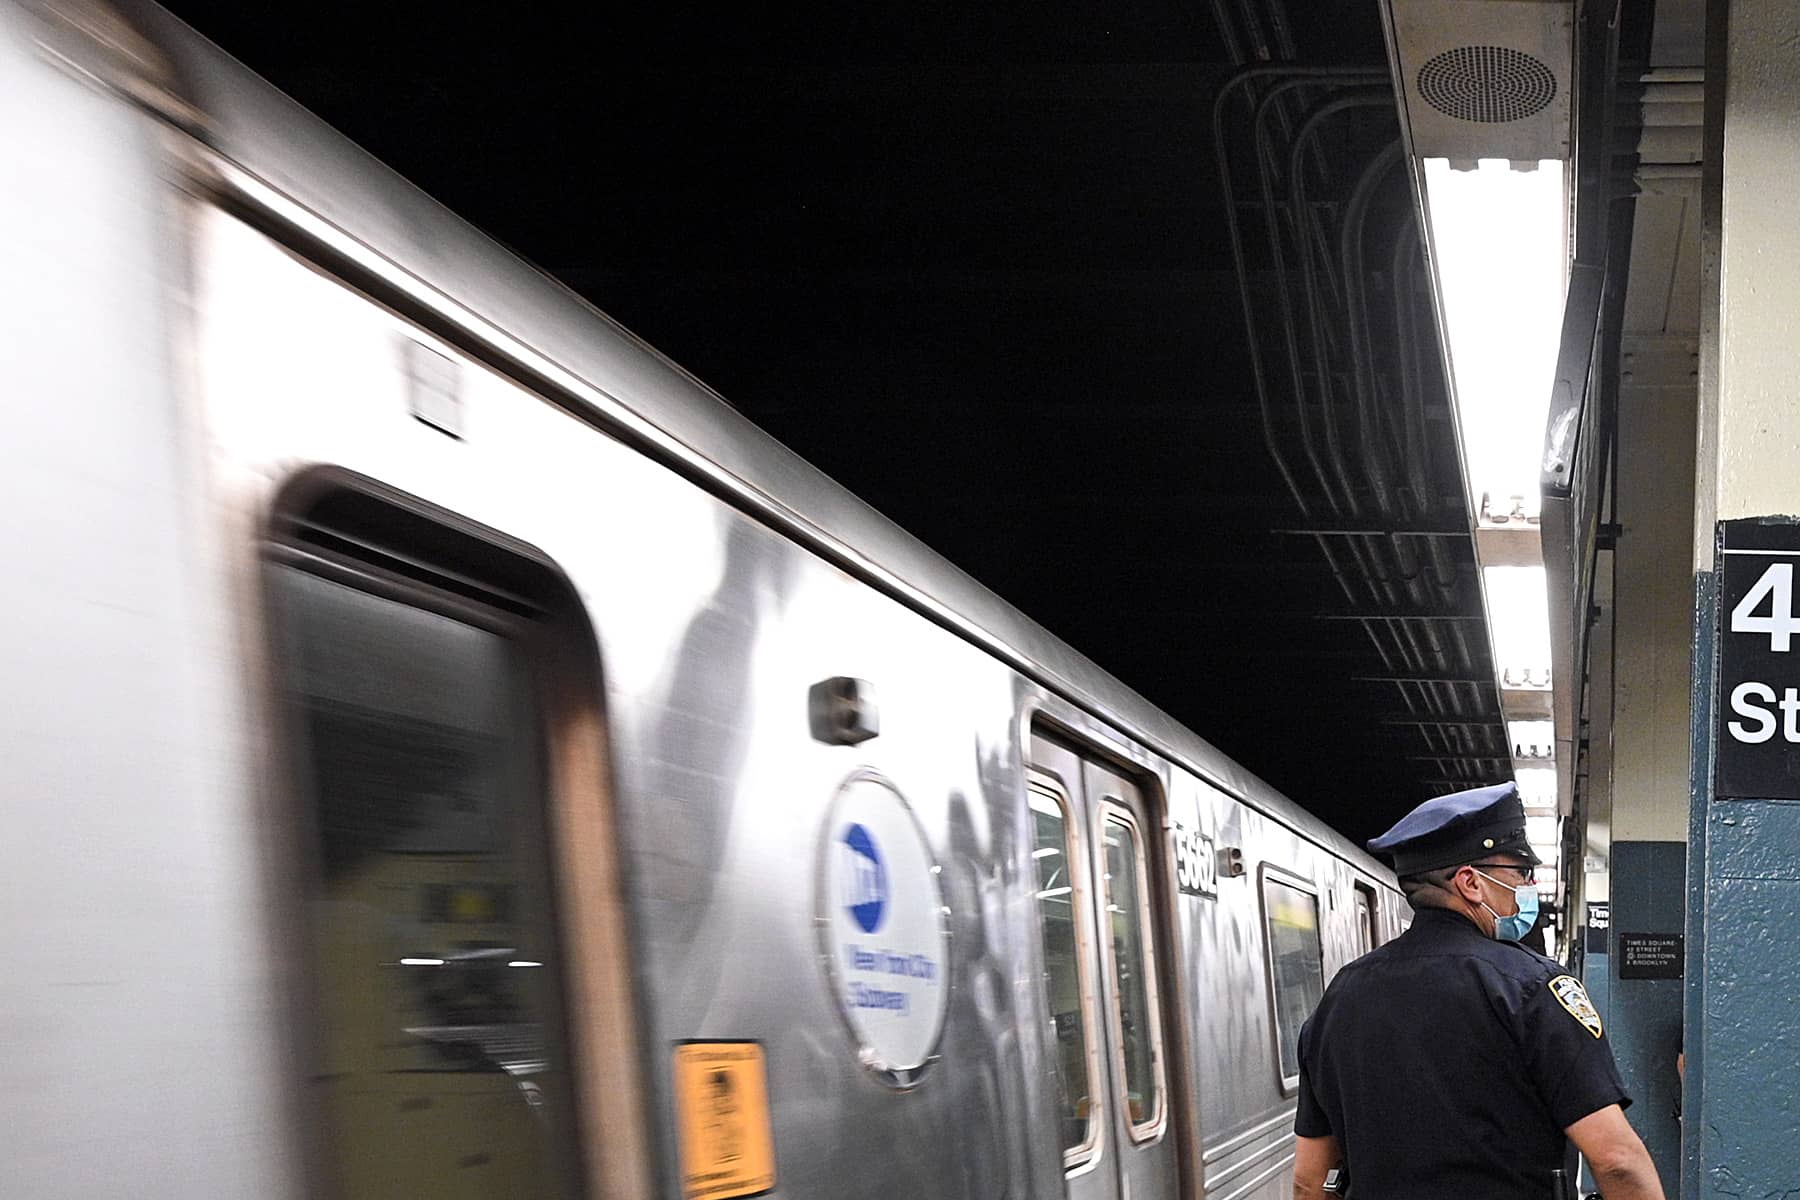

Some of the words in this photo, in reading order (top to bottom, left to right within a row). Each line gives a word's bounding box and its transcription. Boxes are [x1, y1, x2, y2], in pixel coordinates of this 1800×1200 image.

[1176, 831, 1216, 894] 5662
[1589, 908, 1609, 918] Tim
[1589, 918, 1609, 929] Squ
